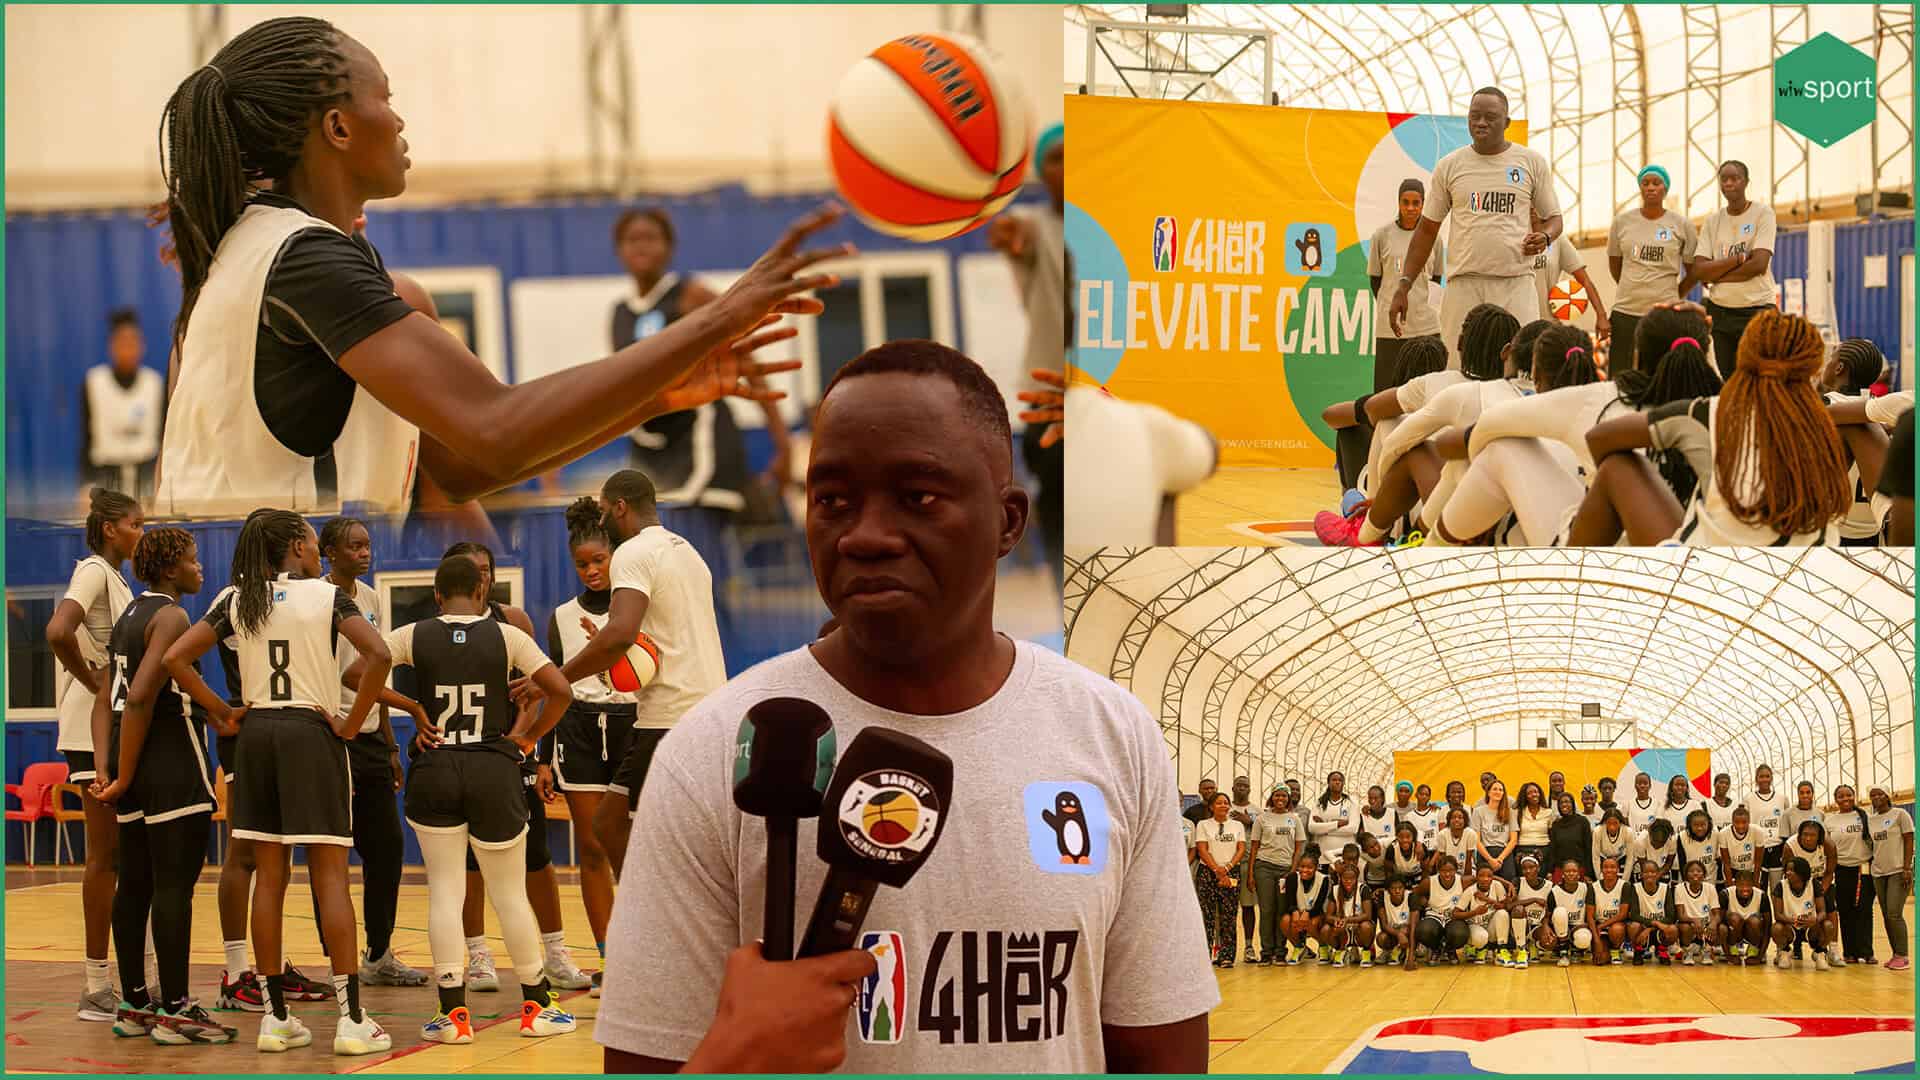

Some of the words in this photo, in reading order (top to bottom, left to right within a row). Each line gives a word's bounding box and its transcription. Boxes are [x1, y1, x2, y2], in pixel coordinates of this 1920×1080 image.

[1078, 279, 1262, 353] ELEVATE
[268, 639, 292, 701] 8
[435, 683, 485, 745] 25
[880, 773, 931, 798] BASKET
